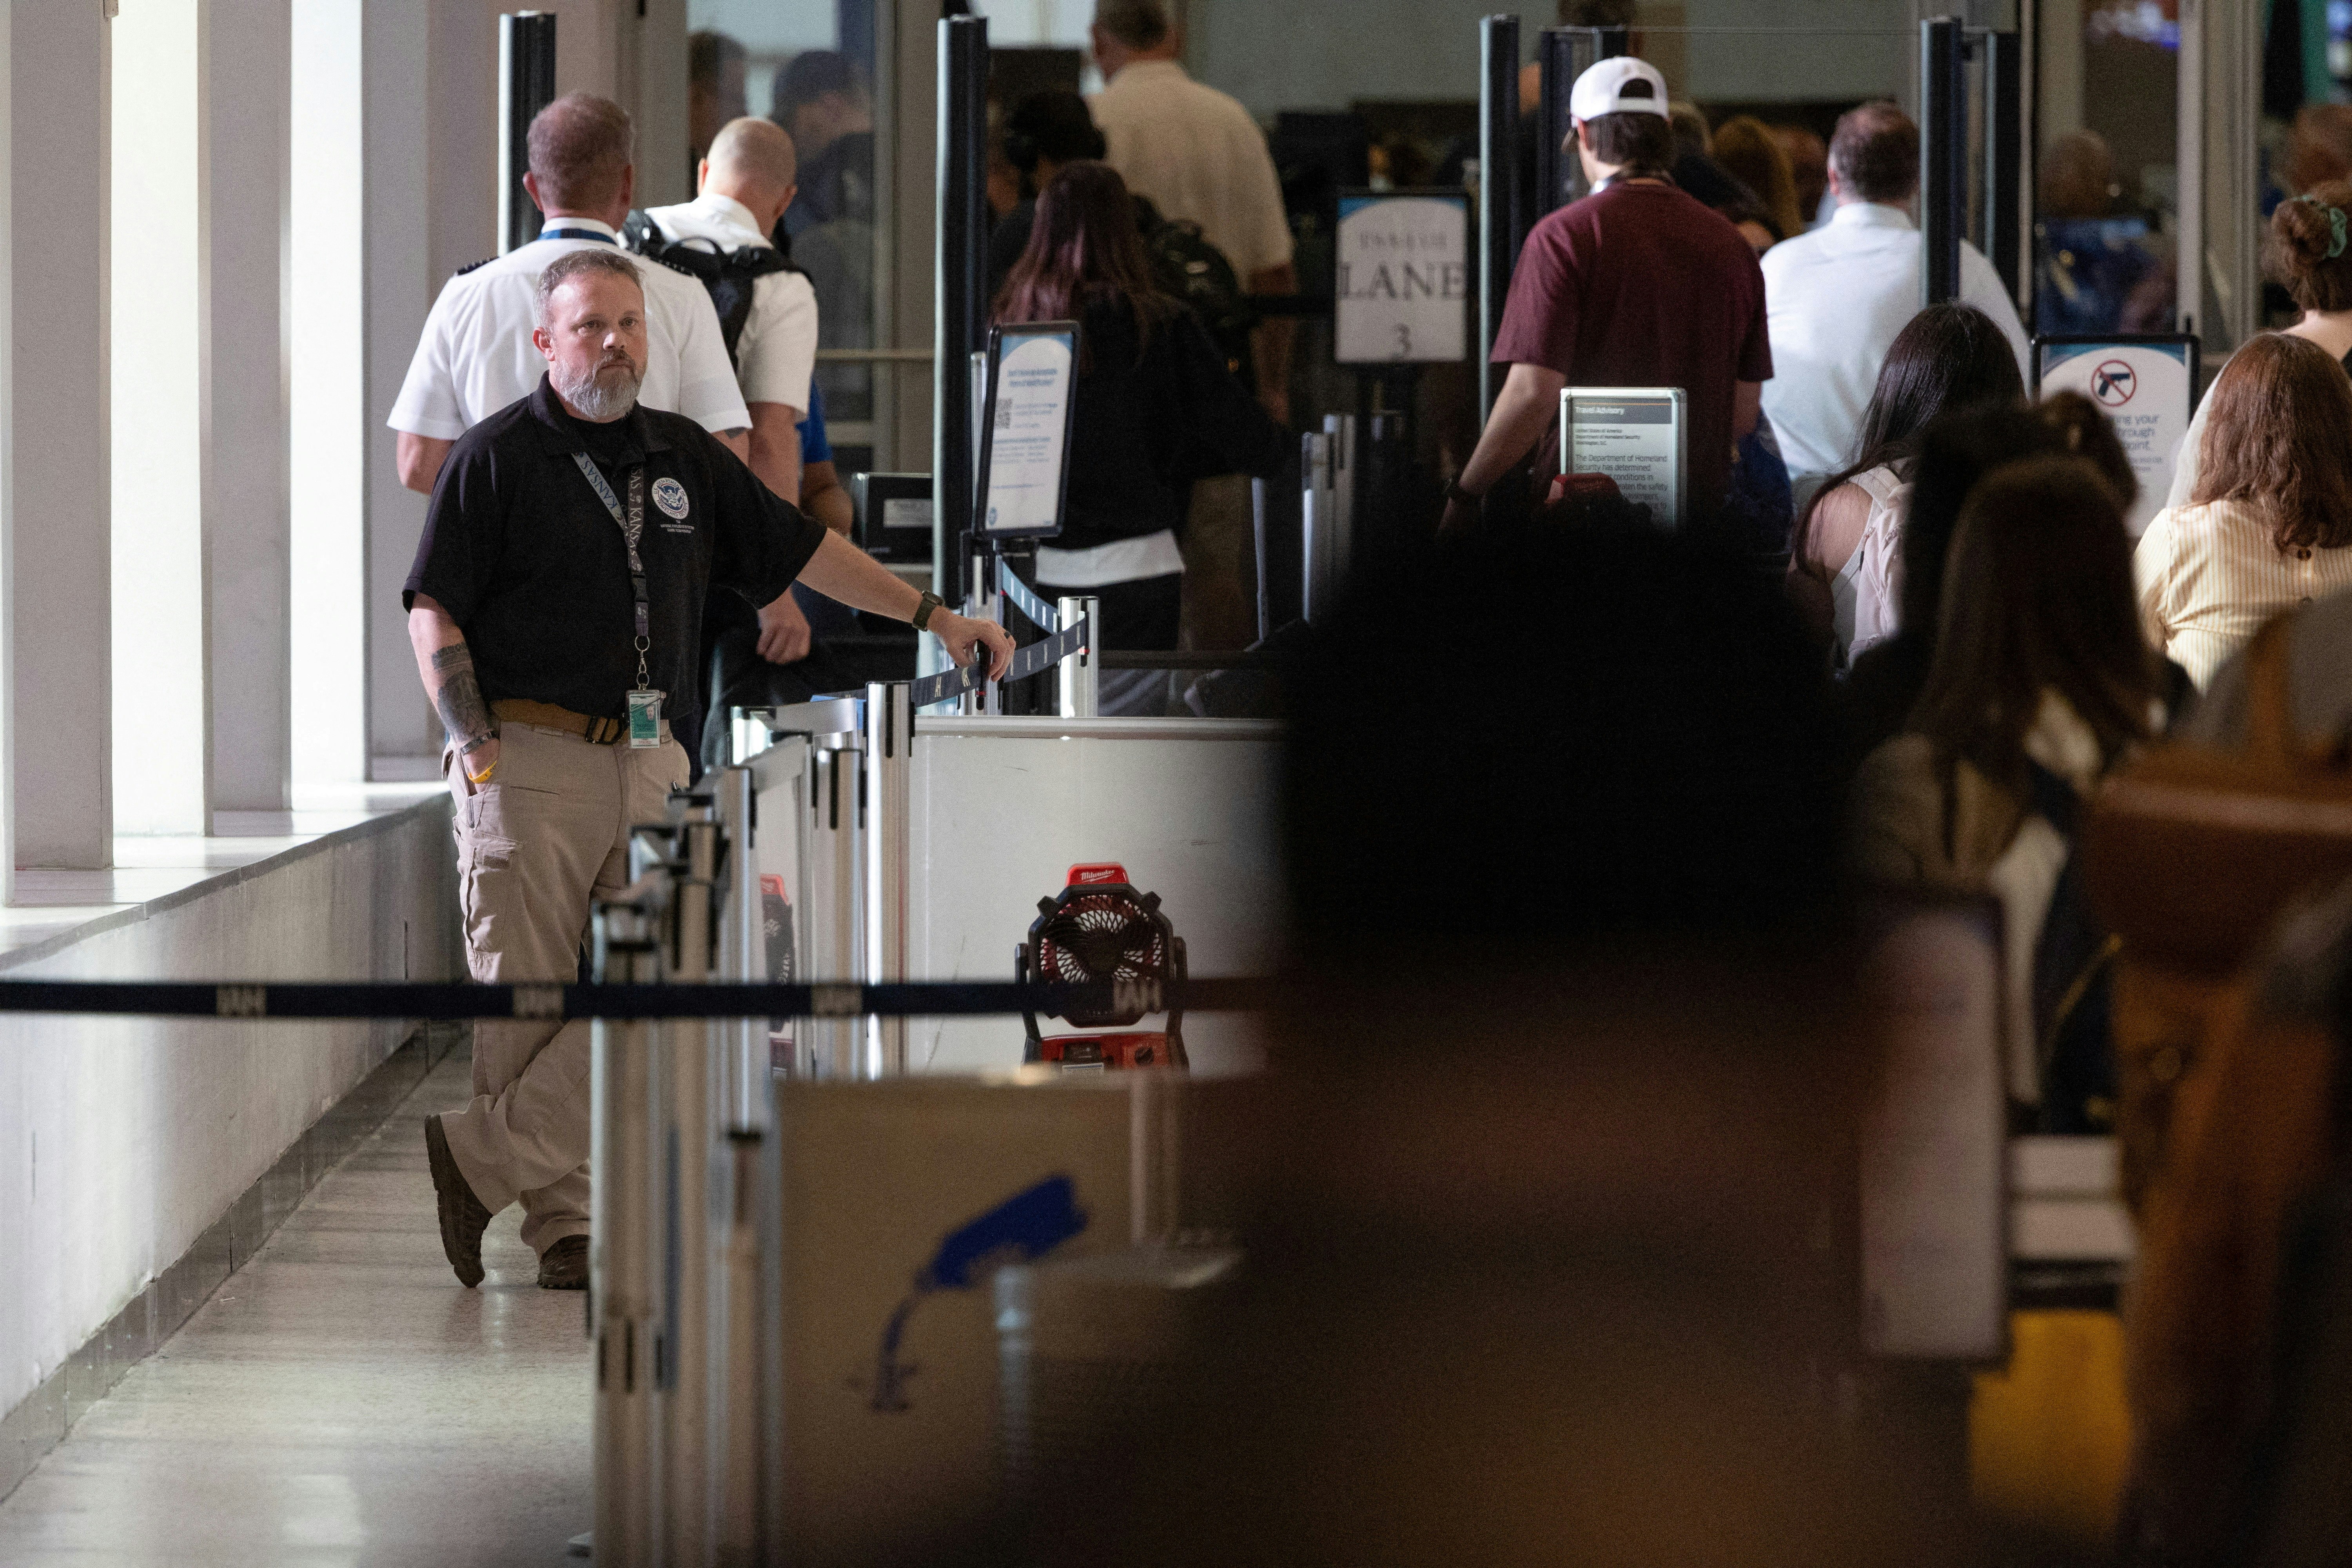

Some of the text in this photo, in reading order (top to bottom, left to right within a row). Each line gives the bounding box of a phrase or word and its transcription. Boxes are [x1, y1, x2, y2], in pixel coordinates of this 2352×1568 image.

[1338, 261, 1466, 300] LANE
[1391, 323, 1412, 360] 3
[1596, 407, 1625, 415] Advisory
[2134, 415, 2159, 425] your
[1589, 455, 1626, 463] Department
[1575, 464, 1601, 472] Security
[581, 460, 618, 510] KANSAS
[1648, 483, 1668, 492] safety
[630, 507, 642, 555] KANSAS
[1080, 869, 1115, 881] Milwaukee
